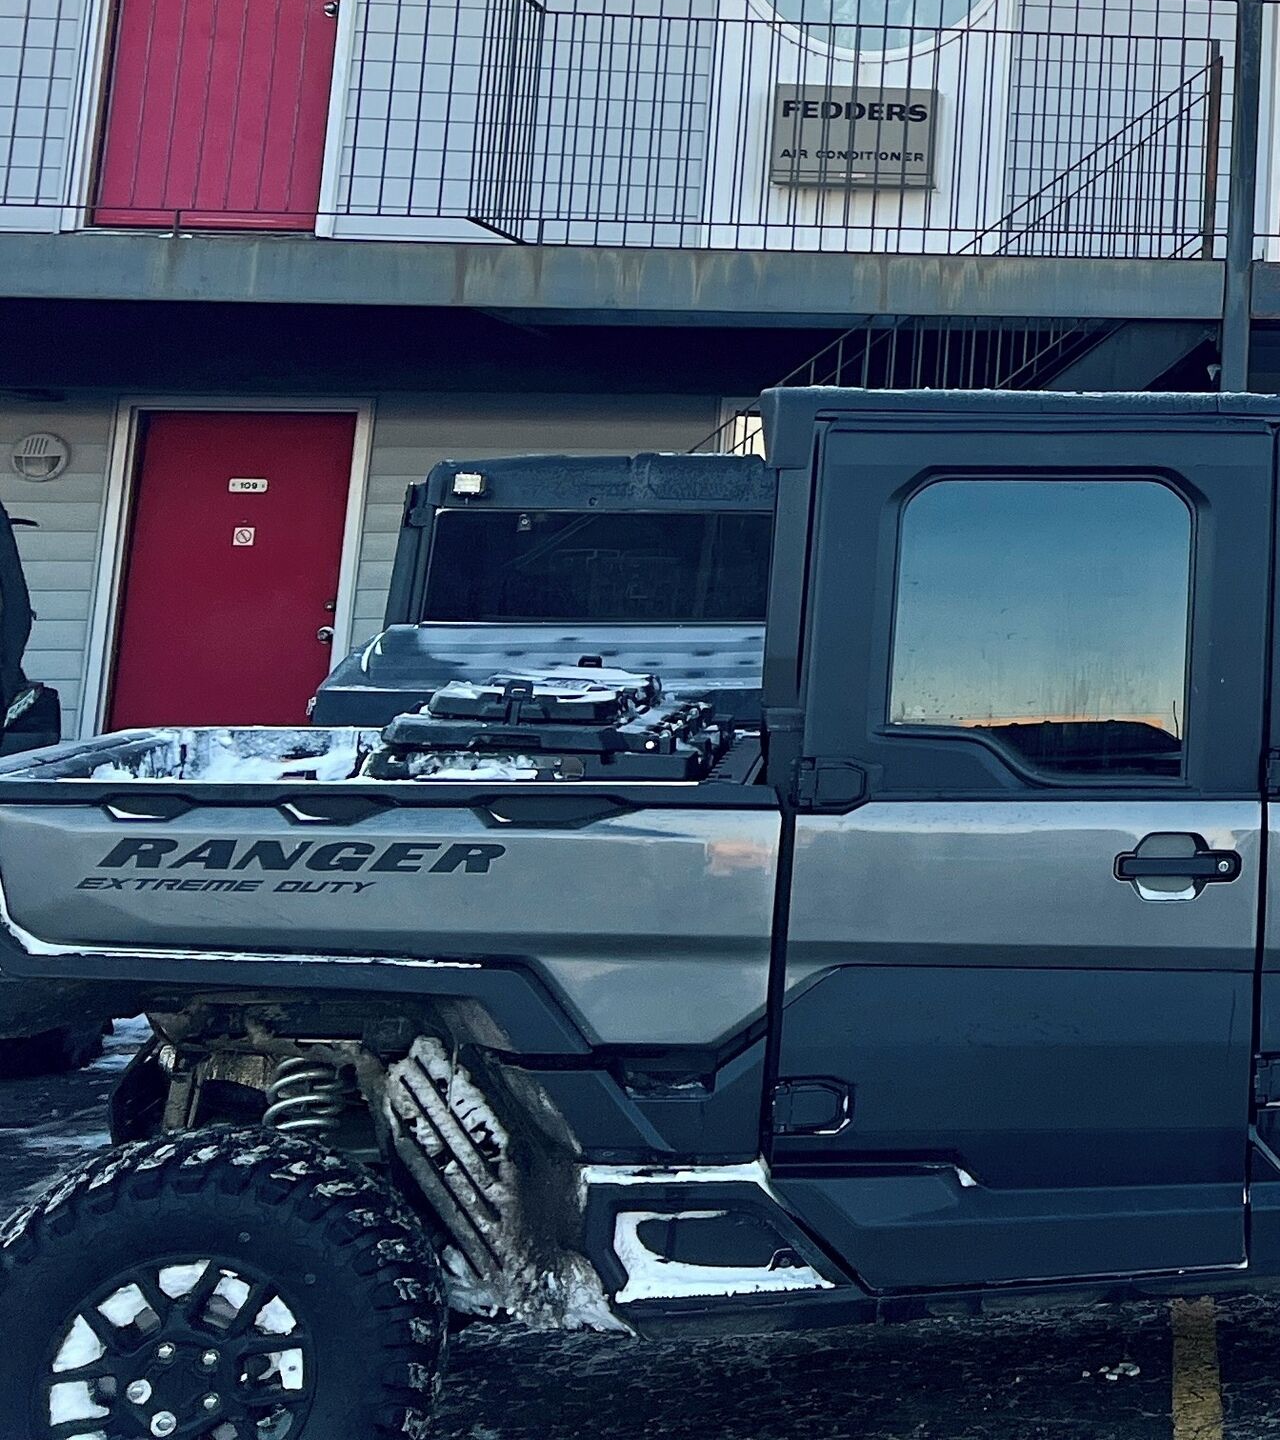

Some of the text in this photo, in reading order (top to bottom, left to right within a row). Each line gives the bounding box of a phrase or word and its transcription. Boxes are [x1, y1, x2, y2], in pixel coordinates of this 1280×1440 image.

[782, 100, 928, 122] FEDDERS
[780, 149, 924, 162] AIR CONDITIONER
[97, 837, 507, 874] RANGER
[75, 877, 377, 894] EXTREME DUTY
